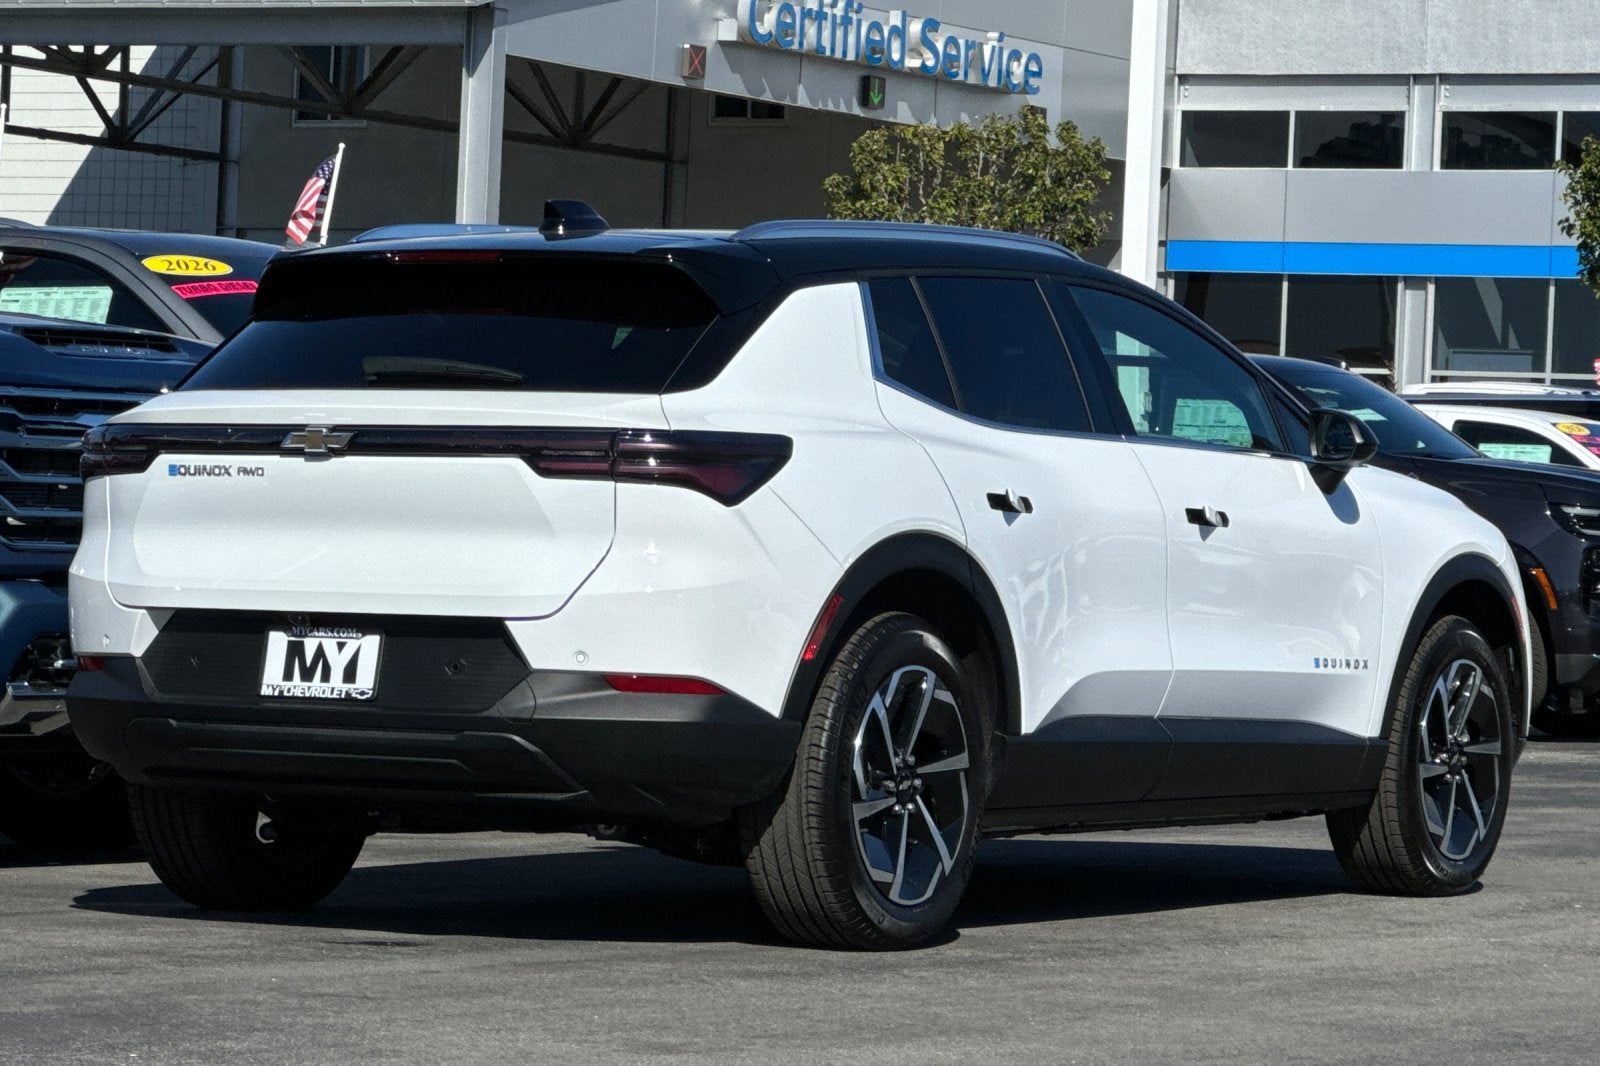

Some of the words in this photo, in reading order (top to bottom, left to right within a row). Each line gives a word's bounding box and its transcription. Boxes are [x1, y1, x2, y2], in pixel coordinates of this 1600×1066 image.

[748, 0, 908, 70] Certified
[919, 18, 1043, 95] Service
[162, 258, 217, 272] 2026
[175, 283, 216, 296] TURBO
[237, 466, 265, 477] AWD
[281, 639, 362, 685] MY
[283, 686, 348, 699] CHEVROLET
